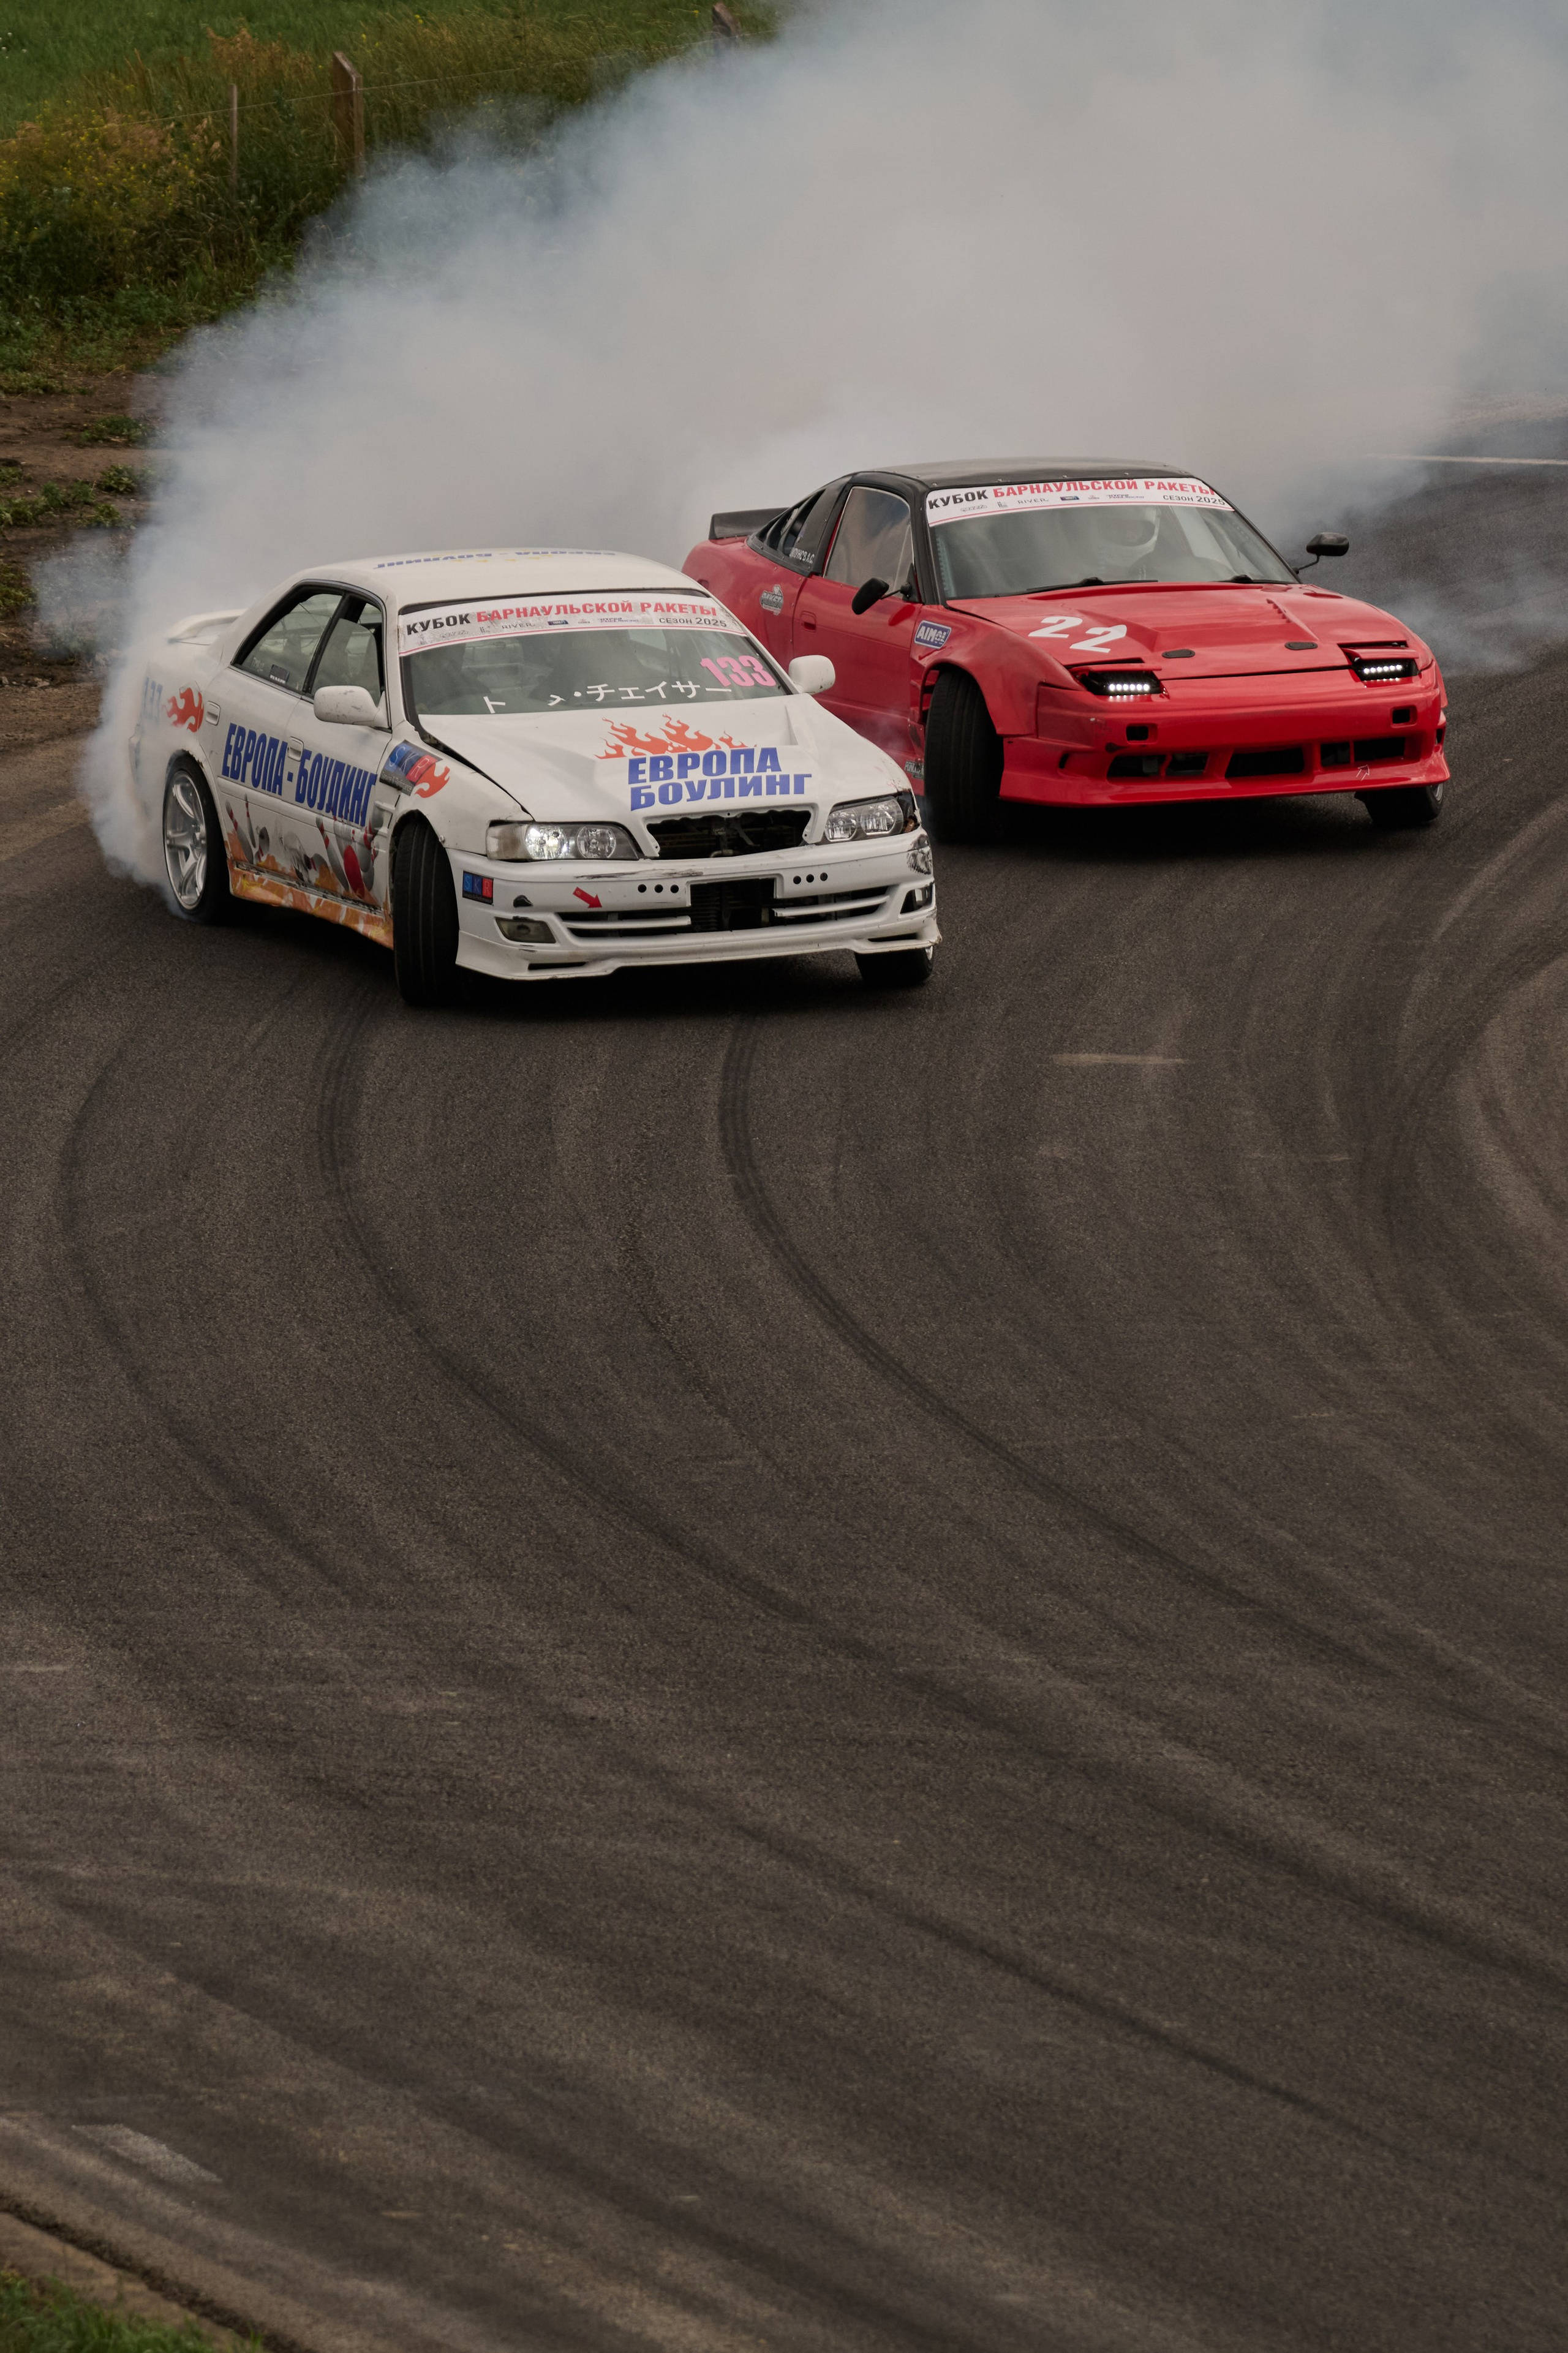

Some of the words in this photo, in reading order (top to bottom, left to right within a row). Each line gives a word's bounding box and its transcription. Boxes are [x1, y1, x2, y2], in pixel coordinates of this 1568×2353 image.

[928, 489, 989, 510] КУБОК
[993, 479, 1138, 498] БАРНАУЛЬСКОЙ
[1144, 481, 1216, 495] РАКЕТЫ
[1197, 495, 1226, 505] 2025
[407, 613, 471, 636] КУБОК
[477, 600, 633, 623] БАРНАУЛЬСКОЙ
[640, 602, 717, 616] РАКЕТЫ
[696, 617, 727, 627] 2025
[916, 626, 947, 642] AIMOL
[1028, 616, 1127, 653] 22
[700, 655, 775, 687] 133
[221, 723, 288, 796] ЕВРОПА
[295, 748, 378, 827] БОУЛИНГ
[389, 746, 429, 778] SKR
[628, 747, 782, 785] ЕВРОПА
[630, 774, 812, 811] БОУЛИНГ
[466, 875, 491, 897] SKR
